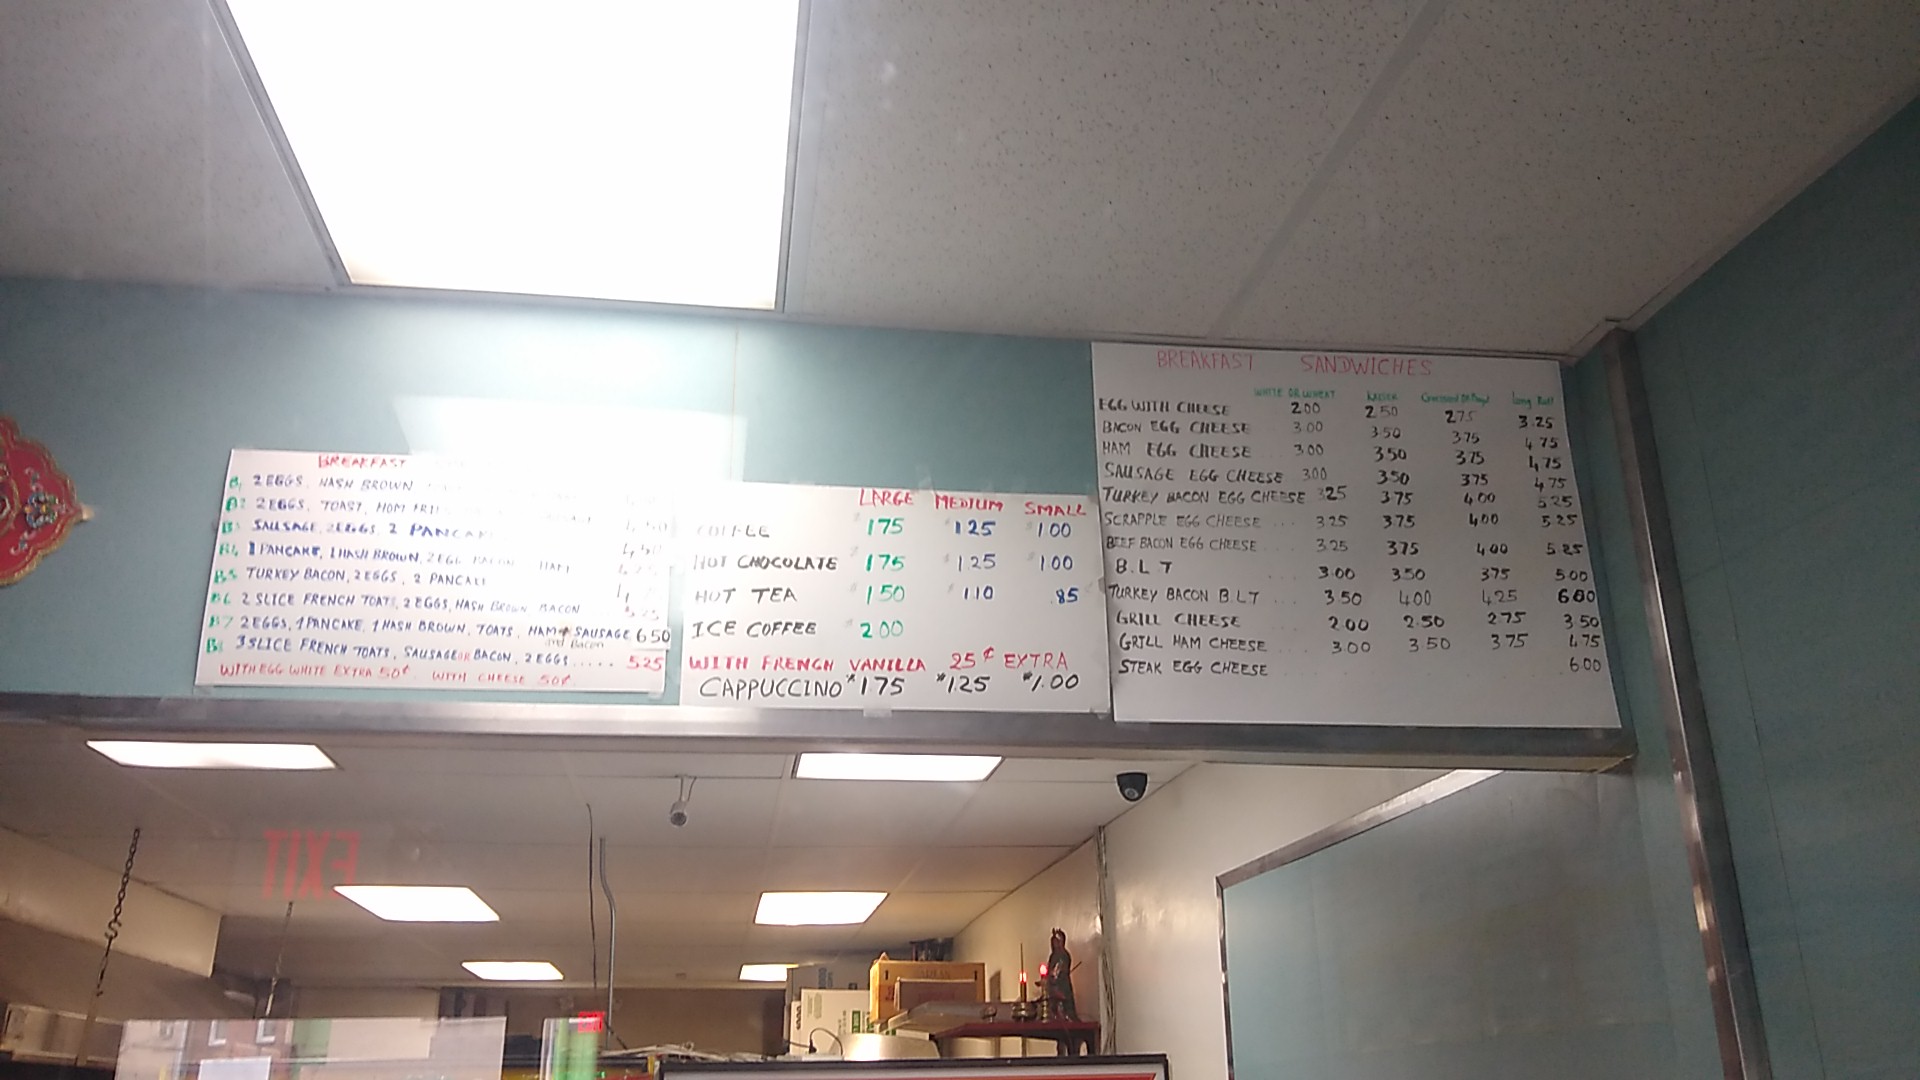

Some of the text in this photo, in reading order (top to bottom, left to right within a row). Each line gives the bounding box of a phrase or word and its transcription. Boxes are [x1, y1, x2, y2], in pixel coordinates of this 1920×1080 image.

[1156, 350, 1434, 378] BREAKFAST SANDWICHES
[1098, 398, 1128, 412] EGG
[1131, 400, 1169, 413] WITH
[1176, 400, 1232, 416] CHEESE
[1102, 420, 1142, 434] BACON
[1150, 420, 1180, 434] EGG
[1190, 420, 1252, 435] CHEESE
[1102, 440, 1131, 456] HAM
[1146, 442, 1177, 458] EGG
[1189, 443, 1252, 458] CHEESE
[318, 454, 407, 470] BREAKFAST
[1104, 462, 1176, 482] SAUSAGE
[1189, 469, 1220, 482] EGG
[1226, 468, 1284, 484] CHEESE
[318, 477, 354, 490] HASH
[858, 488, 1087, 517] LARGE MEDIUM SMALL
[1102, 486, 1159, 504] TURKEY
[1166, 490, 1210, 504] BACON
[1218, 490, 1246, 504] EGG
[1250, 490, 1306, 504] CHEESE
[1104, 511, 1168, 527] SCRAPPLE
[1176, 514, 1200, 528] EGG
[1206, 514, 1262, 528] CHEESE
[1106, 534, 1136, 550] BEEF
[1140, 536, 1173, 550] BACON
[1180, 536, 1204, 550] EGG
[1209, 539, 1257, 552] CHEESE
[737, 554, 838, 571] CHOCOLATE
[246, 566, 299, 582] TURKEY
[255, 592, 294, 607] SLICE
[302, 592, 356, 606] FRENCH
[456, 598, 484, 611] HASH
[695, 588, 736, 604] HOT
[751, 587, 798, 604] TEA
[1108, 583, 1158, 602] TURKEY
[1166, 586, 1208, 602] BACON
[1116, 609, 1162, 626] GRILL
[1174, 612, 1241, 628] CHEESE
[574, 626, 630, 640] SAUSAGE
[691, 620, 737, 640] ICE
[746, 621, 818, 638] COFFEE
[248, 636, 292, 652] SLICE
[300, 636, 348, 655] FRENCH
[404, 645, 458, 660] SAUSAGE
[1118, 632, 1164, 651] GRILL
[1172, 634, 1201, 650] HAM
[1208, 636, 1268, 652] CHEESE
[220, 663, 256, 676] WITH
[258, 664, 284, 674] EGG
[289, 664, 326, 676] WHITE
[689, 655, 749, 670] WITH
[761, 654, 834, 672] FRENCH
[849, 657, 926, 672] VANILLA
[1004, 650, 1069, 671] EXTRA
[1118, 658, 1163, 676] STEAK
[1172, 660, 1203, 674] EGG
[1210, 660, 1269, 677] CHEESE
[432, 670, 467, 683] WITH
[700, 676, 842, 700] CAPPUCCINO
